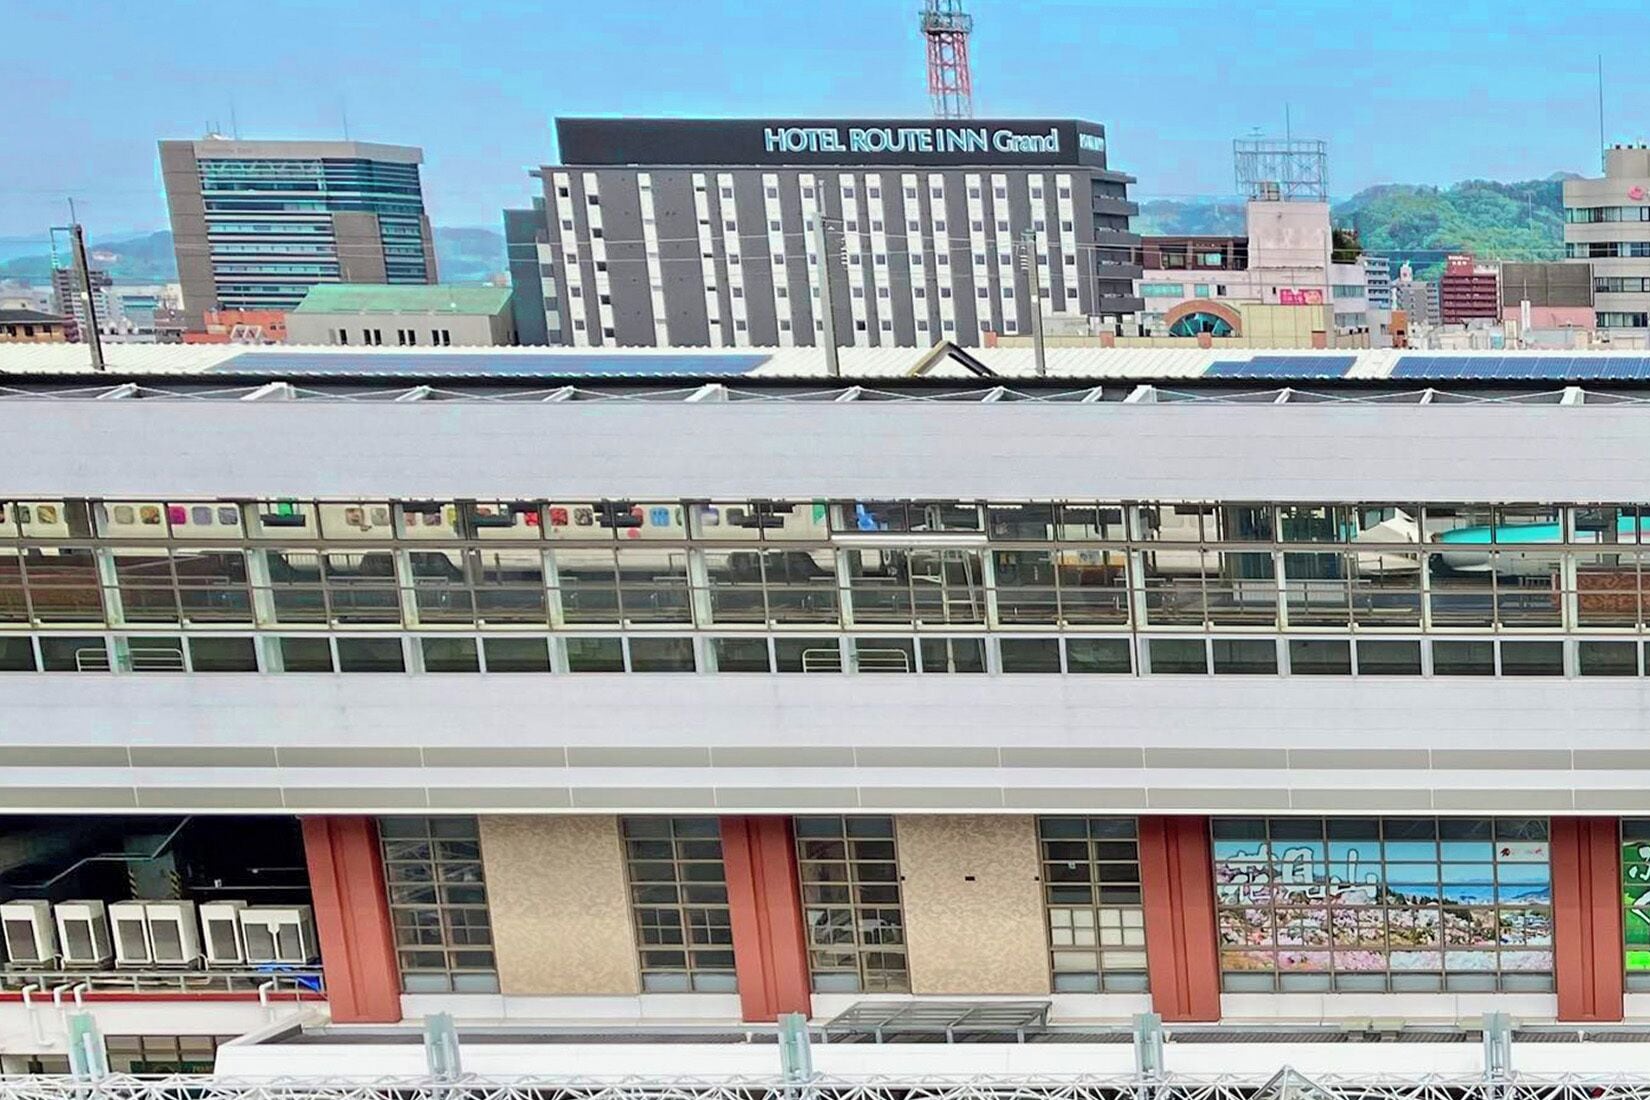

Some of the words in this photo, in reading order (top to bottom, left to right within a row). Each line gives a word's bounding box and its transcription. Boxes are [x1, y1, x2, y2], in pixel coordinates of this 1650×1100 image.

[764, 127, 847, 152] HOTEL
[849, 127, 933, 152] ROUTE
[935, 127, 988, 152] INN
[993, 127, 1060, 152] Grand
